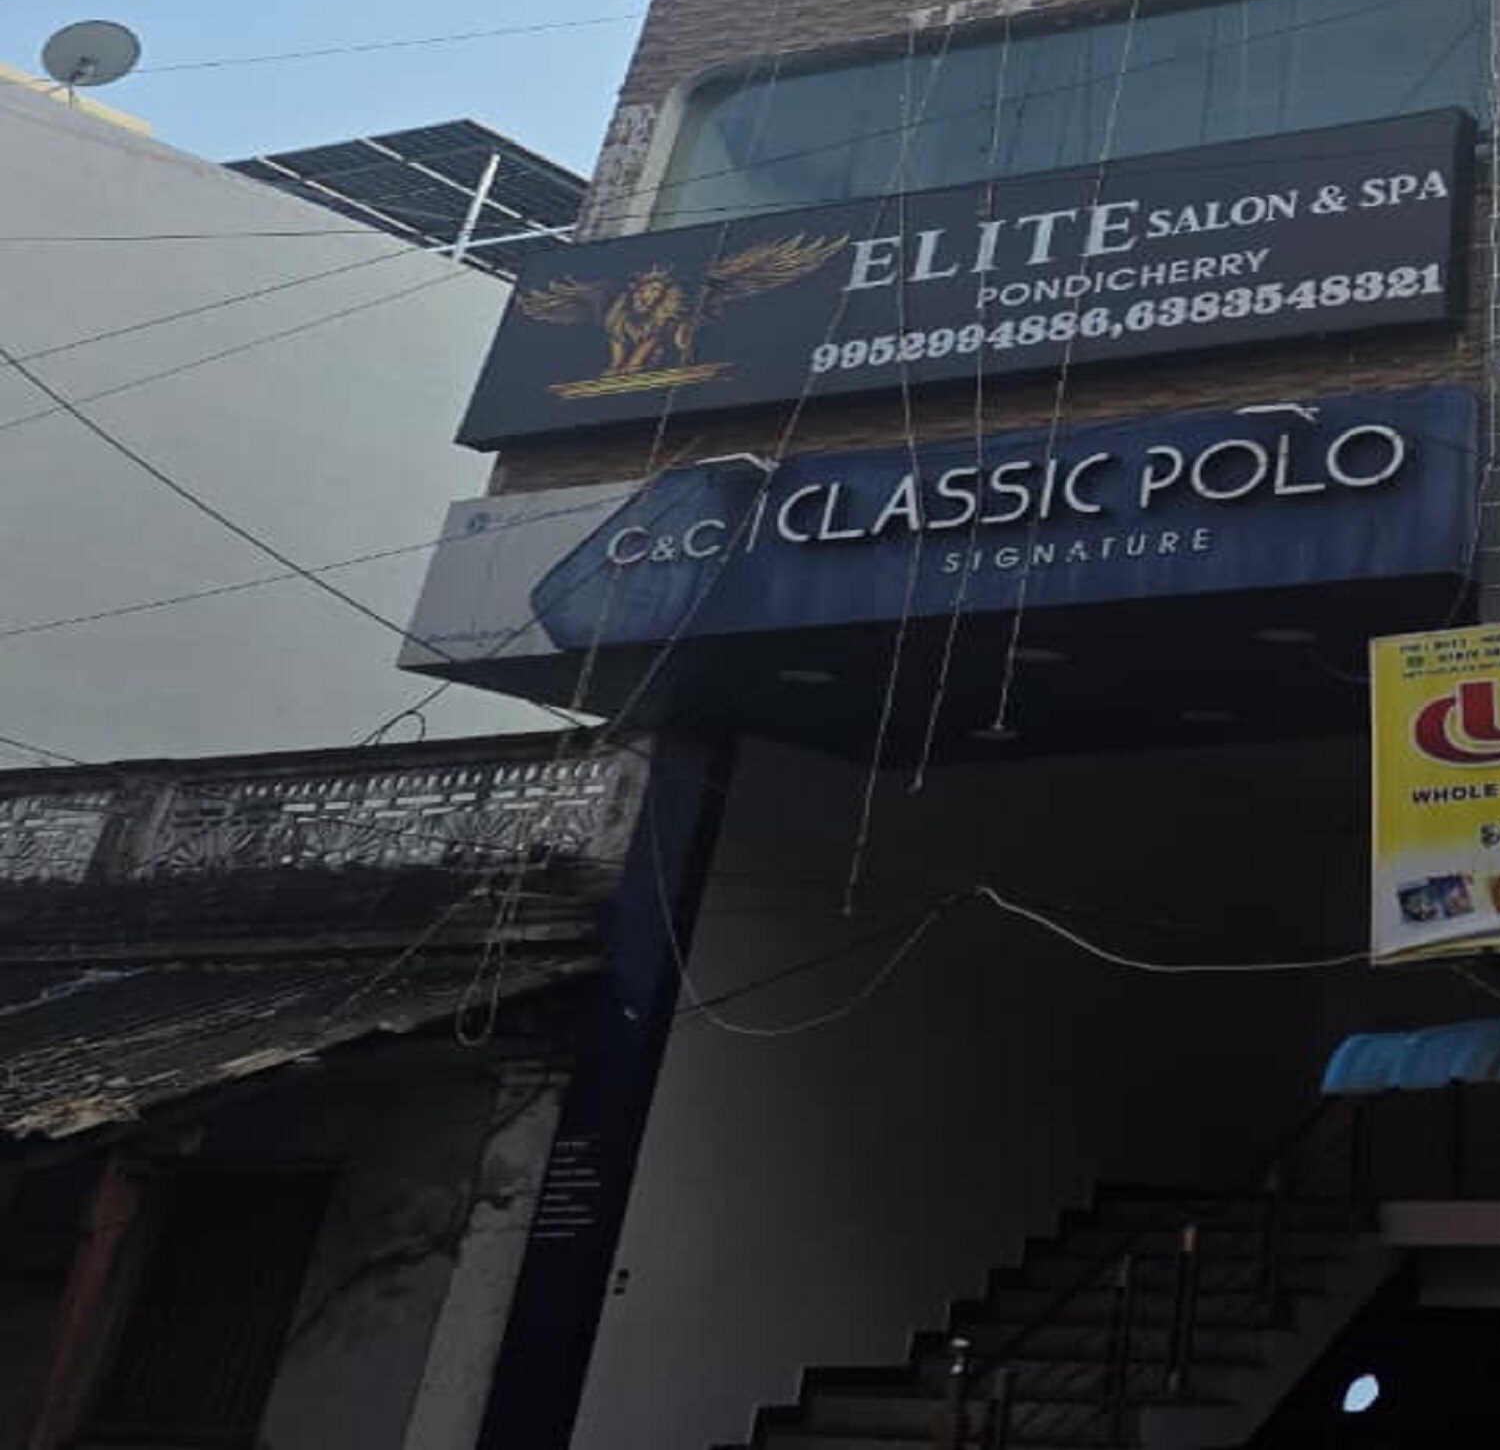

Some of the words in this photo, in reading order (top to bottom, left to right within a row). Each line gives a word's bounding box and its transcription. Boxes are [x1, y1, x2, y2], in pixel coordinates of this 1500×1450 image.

[844, 200, 1140, 292] ELITE
[1145, 189, 1299, 239] SALON
[1311, 183, 1348, 216] &
[1358, 170, 1449, 208] SPA
[976, 249, 1270, 308] PONDICHERRY
[811, 263, 1444, 373] 9952994886,6383548321
[777, 451, 1112, 542] CLASSIC
[1140, 423, 1404, 510] POLO
[606, 519, 727, 566] C&C
[942, 528, 1214, 574] SIGNATURE
[1412, 783, 1500, 803] WHOLE
